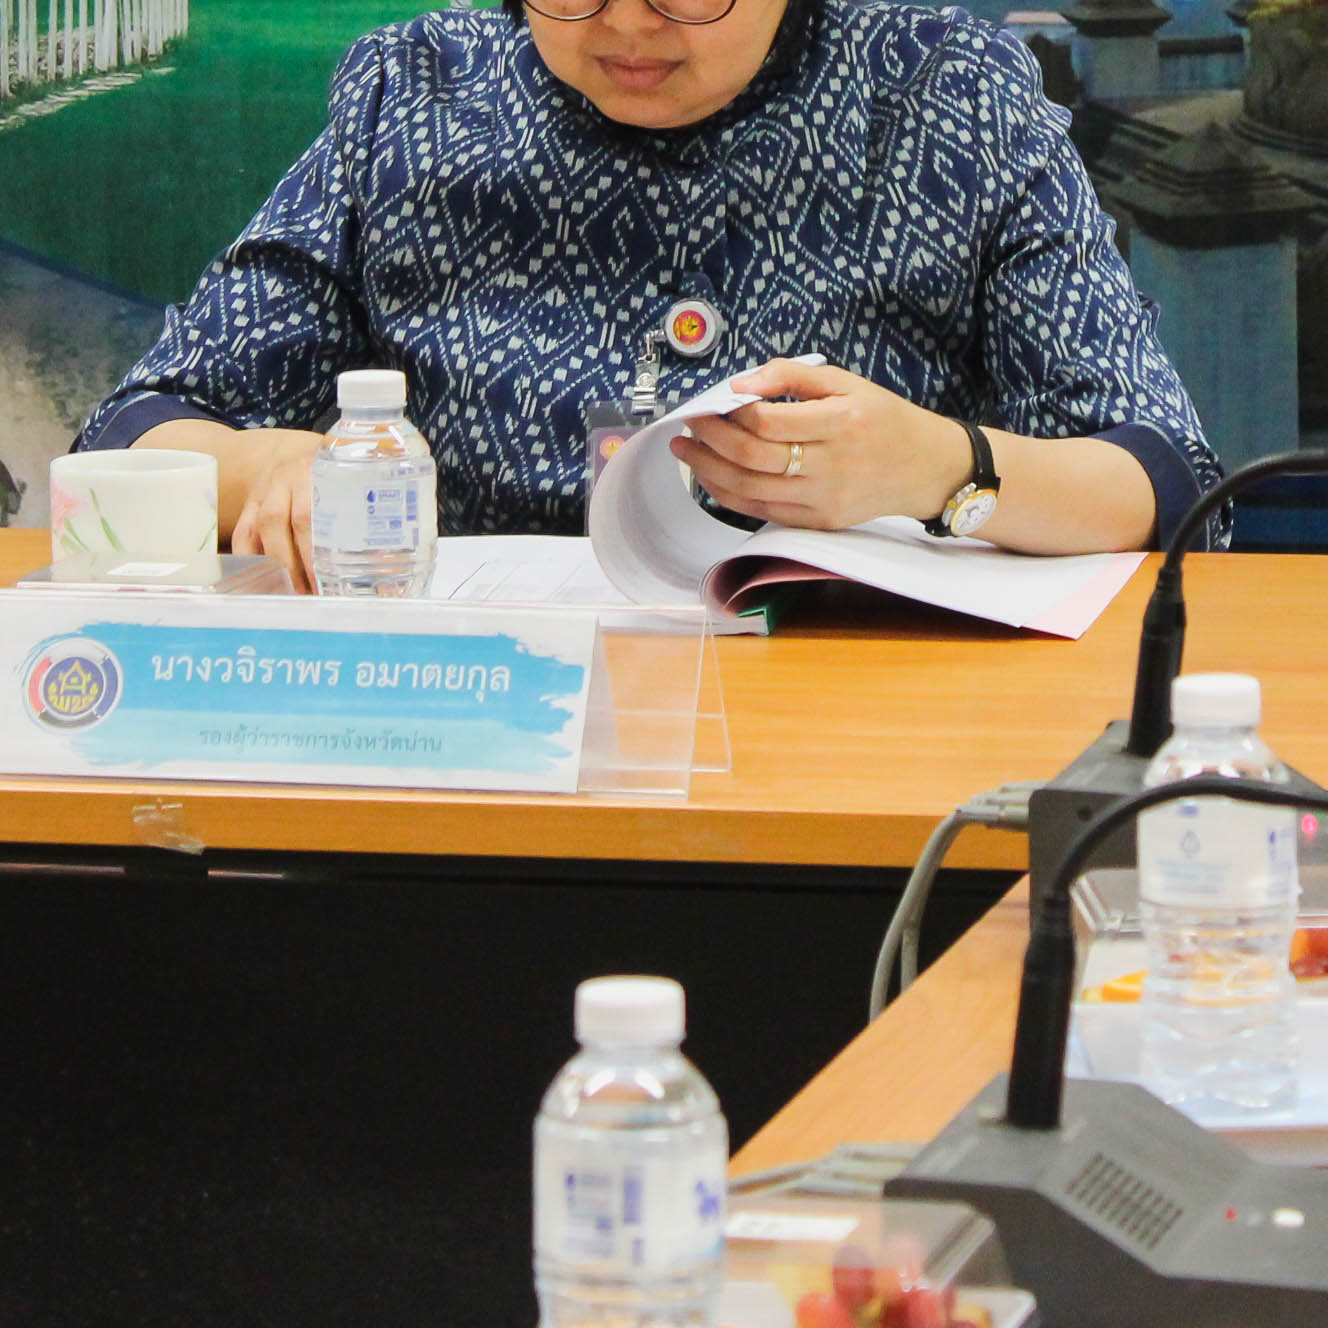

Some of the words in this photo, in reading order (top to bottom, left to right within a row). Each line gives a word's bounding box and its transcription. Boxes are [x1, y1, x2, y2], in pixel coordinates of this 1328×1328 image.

[150, 644, 342, 686] นางวจิราพร
[355, 658, 512, 704] อมาตยกุล
